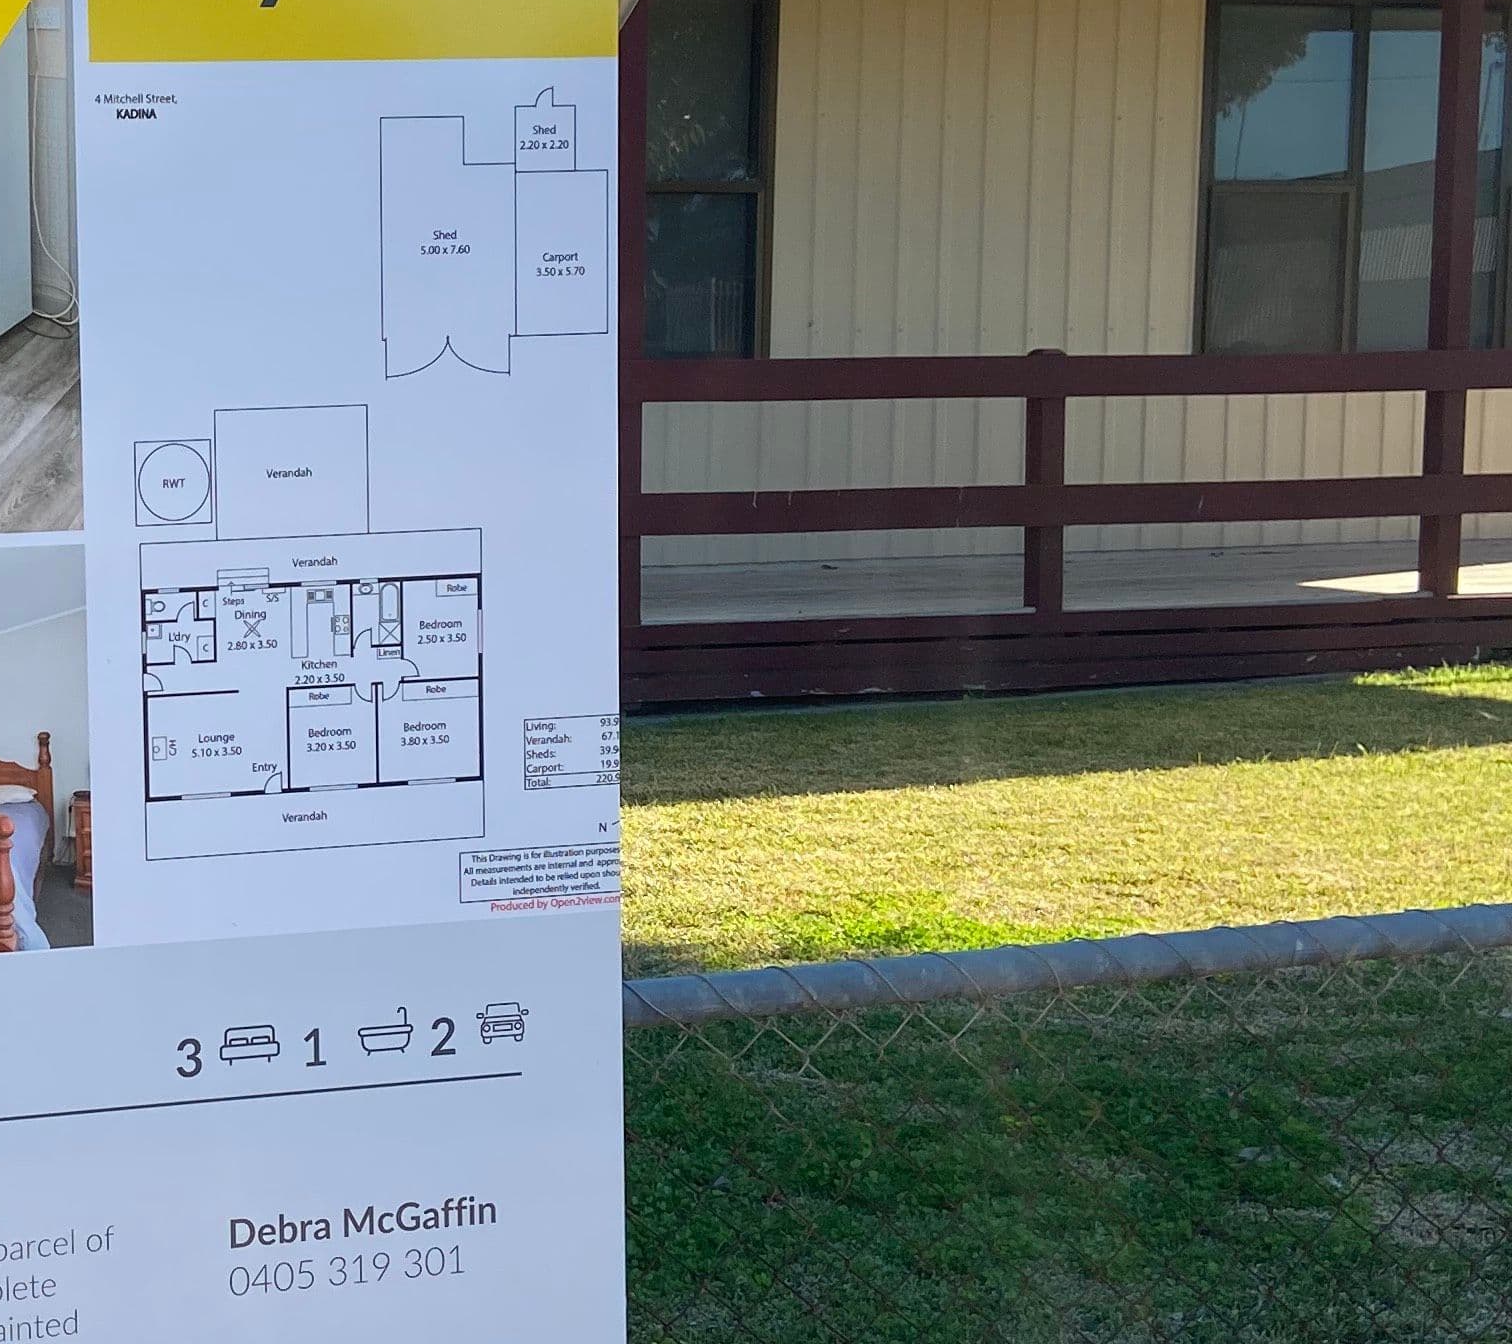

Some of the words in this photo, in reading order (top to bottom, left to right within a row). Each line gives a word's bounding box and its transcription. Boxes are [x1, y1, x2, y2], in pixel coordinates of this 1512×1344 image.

[94, 94, 101, 104] 4
[103, 93, 143, 104] Mitchell
[116, 108, 157, 120] KADINA
[532, 125, 556, 135] Shed
[520, 140, 539, 150] 2.20
[549, 140, 569, 150] 2.20
[433, 230, 457, 240] Shed
[420, 245, 440, 255] 5.00
[450, 244, 470, 254] 7.60
[542, 252, 578, 263] Carport
[536, 267, 556, 277] 3.50
[565, 266, 585, 276] 5.70
[266, 467, 312, 479] Verandah
[162, 478, 186, 489] RWT
[292, 556, 338, 568] Verandah
[446, 584, 467, 592] Robe
[234, 610, 267, 620] Dining
[419, 620, 462, 630] Bedroom
[417, 634, 438, 644] 2.50
[446, 633, 467, 643] 3.50
[227, 641, 248, 651] 2.80
[258, 639, 278, 649] 3.50
[301, 659, 338, 670] Kitchen
[295, 675, 315, 685] 2.20
[324, 673, 345, 683] 3.50
[426, 685, 447, 694] Robe
[308, 692, 330, 701] Robe
[403, 721, 447, 732] Bedroom
[525, 721, 557, 732] Living:
[308, 727, 352, 738] Bedroom
[198, 733, 235, 744] Lounge
[401, 736, 421, 747] 3.80
[430, 735, 450, 745] 3.50
[525, 734, 572, 746] Verandah:
[191, 747, 212, 758] 5.10
[221, 746, 242, 756] 3.50
[306, 742, 327, 753] 3.20
[336, 741, 356, 751] 3.50
[526, 749, 556, 760] Sheds:
[252, 762, 278, 773] Entry
[526, 763, 564, 775] Carport:
[527, 777, 552, 788] Total:
[282, 811, 328, 823] Verandah
[176, 1038, 202, 1078] 3
[304, 1028, 327, 1067] 1
[431, 1017, 456, 1056] 2
[230, 1214, 331, 1249] Debra
[343, 1196, 498, 1237] McGaffin
[87, 1225, 114, 1252] of
[229, 1259, 316, 1297] 0405
[329, 1252, 390, 1286] 319
[404, 1244, 466, 1279] 301
